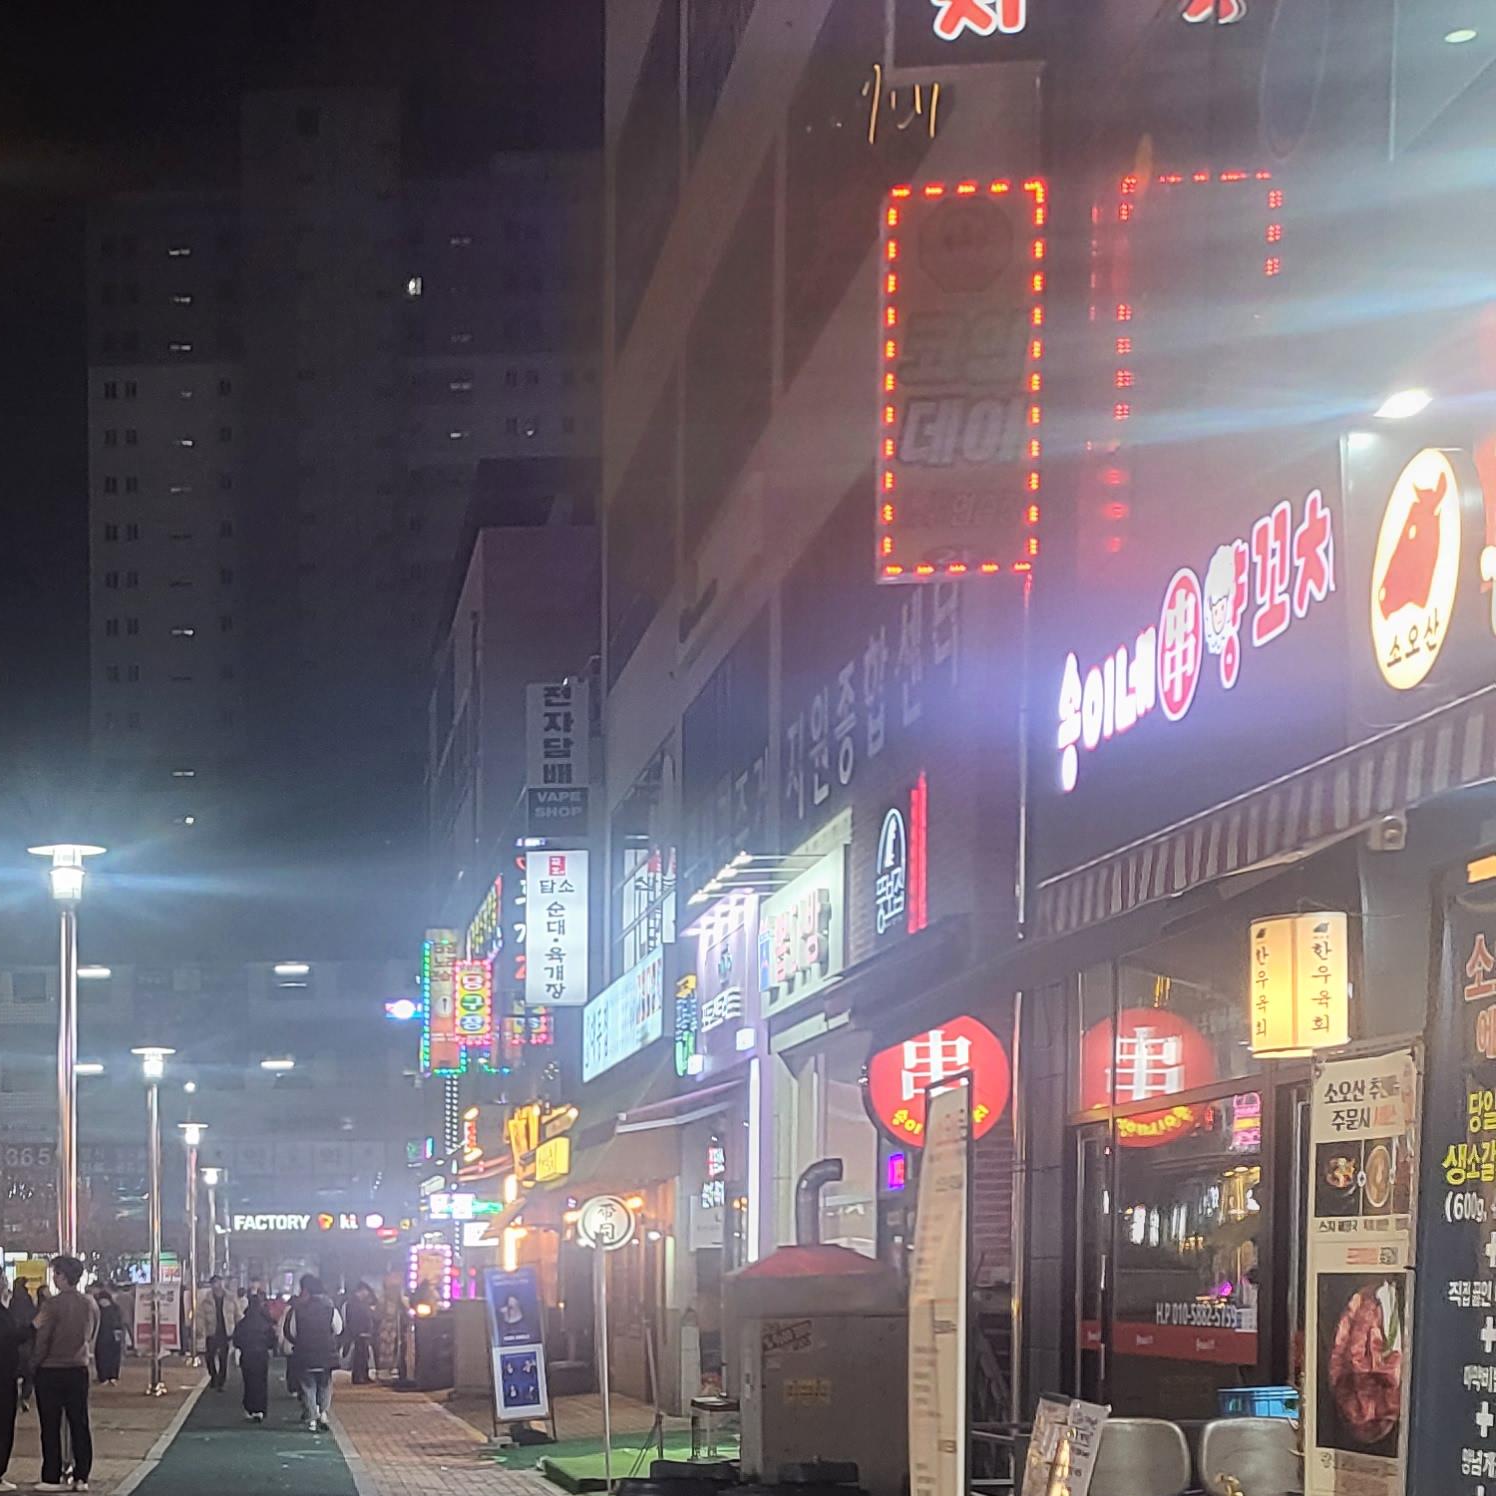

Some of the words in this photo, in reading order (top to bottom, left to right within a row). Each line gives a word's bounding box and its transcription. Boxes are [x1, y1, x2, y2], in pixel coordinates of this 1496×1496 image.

[1387, 608, 1440, 667] 소오산
[542, 684, 574, 785] 전자담배
[537, 790, 581, 803] VAPE
[534, 806, 583, 819] SHOP
[539, 879, 575, 895] 담소
[1310, 940, 1332, 1032] 한우육회
[901, 1030, 973, 1101] 串
[1323, 1078, 1366, 1104] 소오산
[1331, 1107, 1372, 1132] 주문시
[233, 1213, 310, 1231] FACTORY
